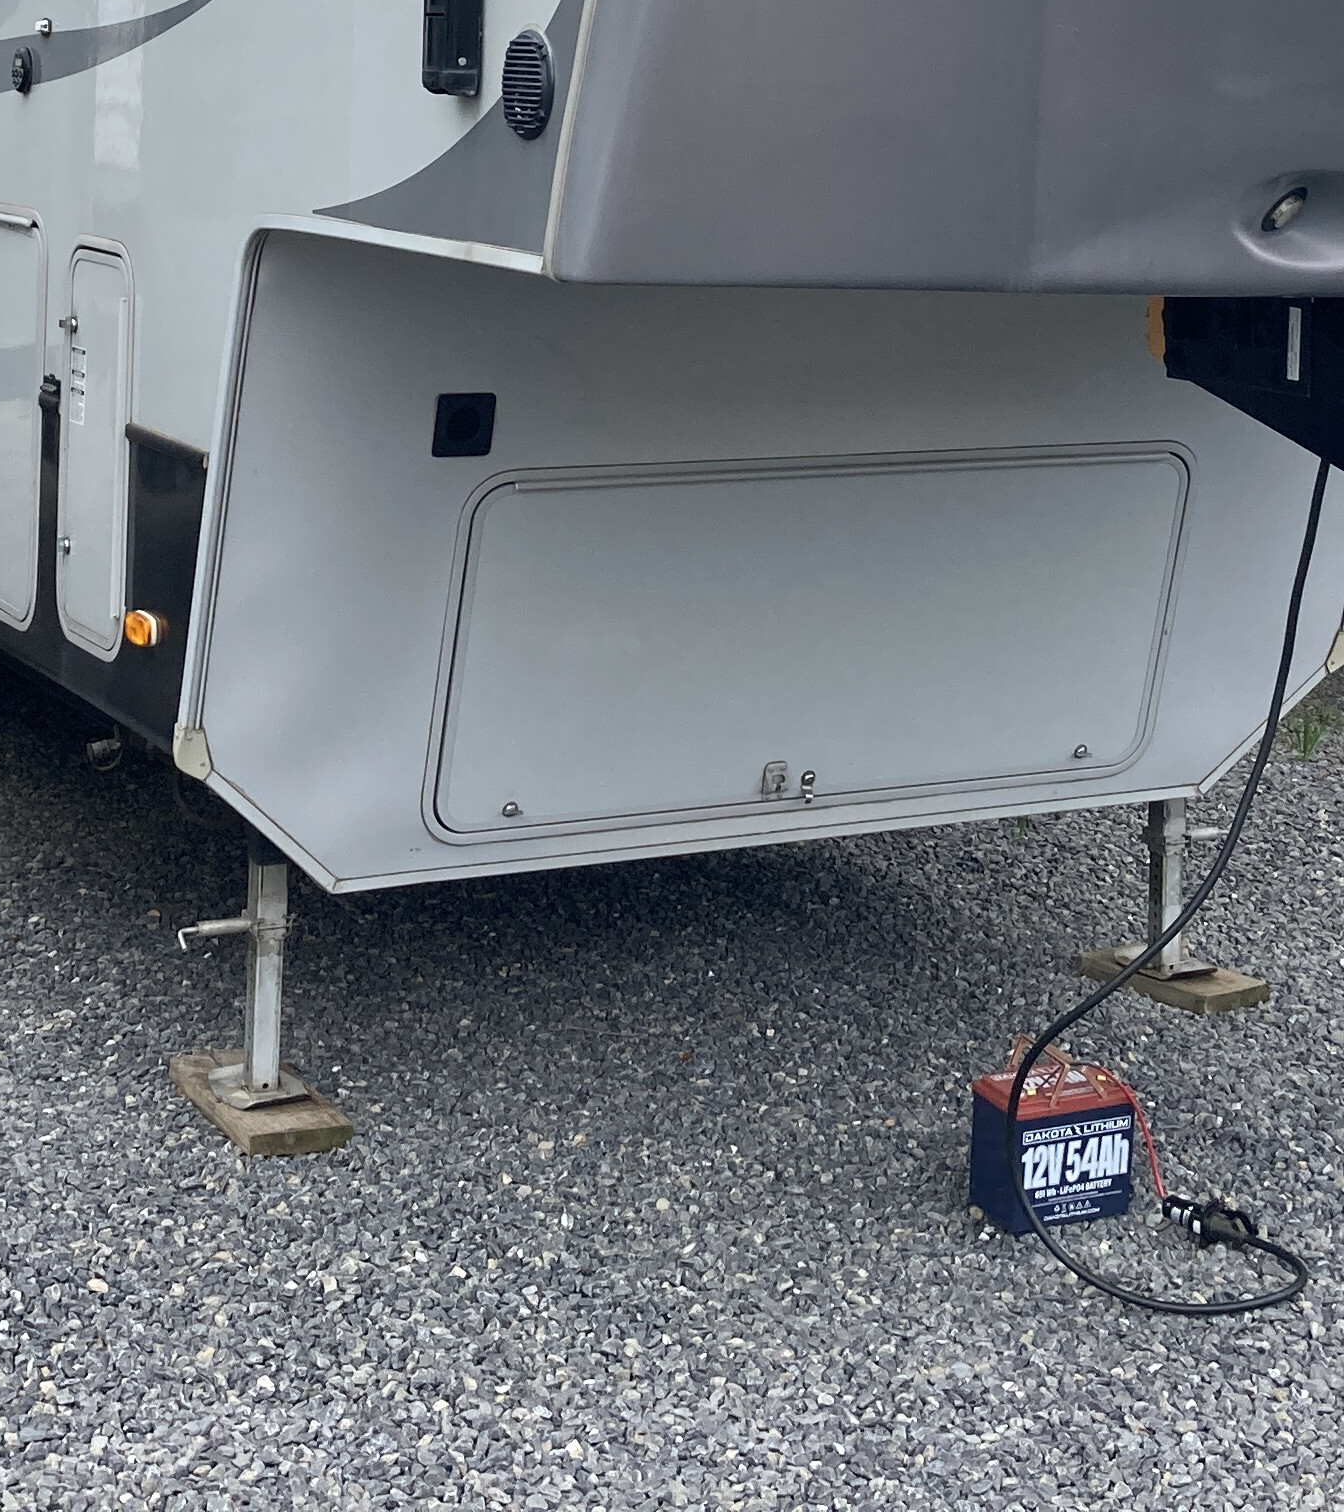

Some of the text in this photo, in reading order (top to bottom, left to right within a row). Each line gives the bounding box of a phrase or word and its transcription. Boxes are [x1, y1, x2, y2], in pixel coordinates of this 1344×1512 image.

[1025, 1118, 1129, 1143] DAKOTA LITHIUM
[1021, 1133, 1130, 1190] 12V 54Ah
